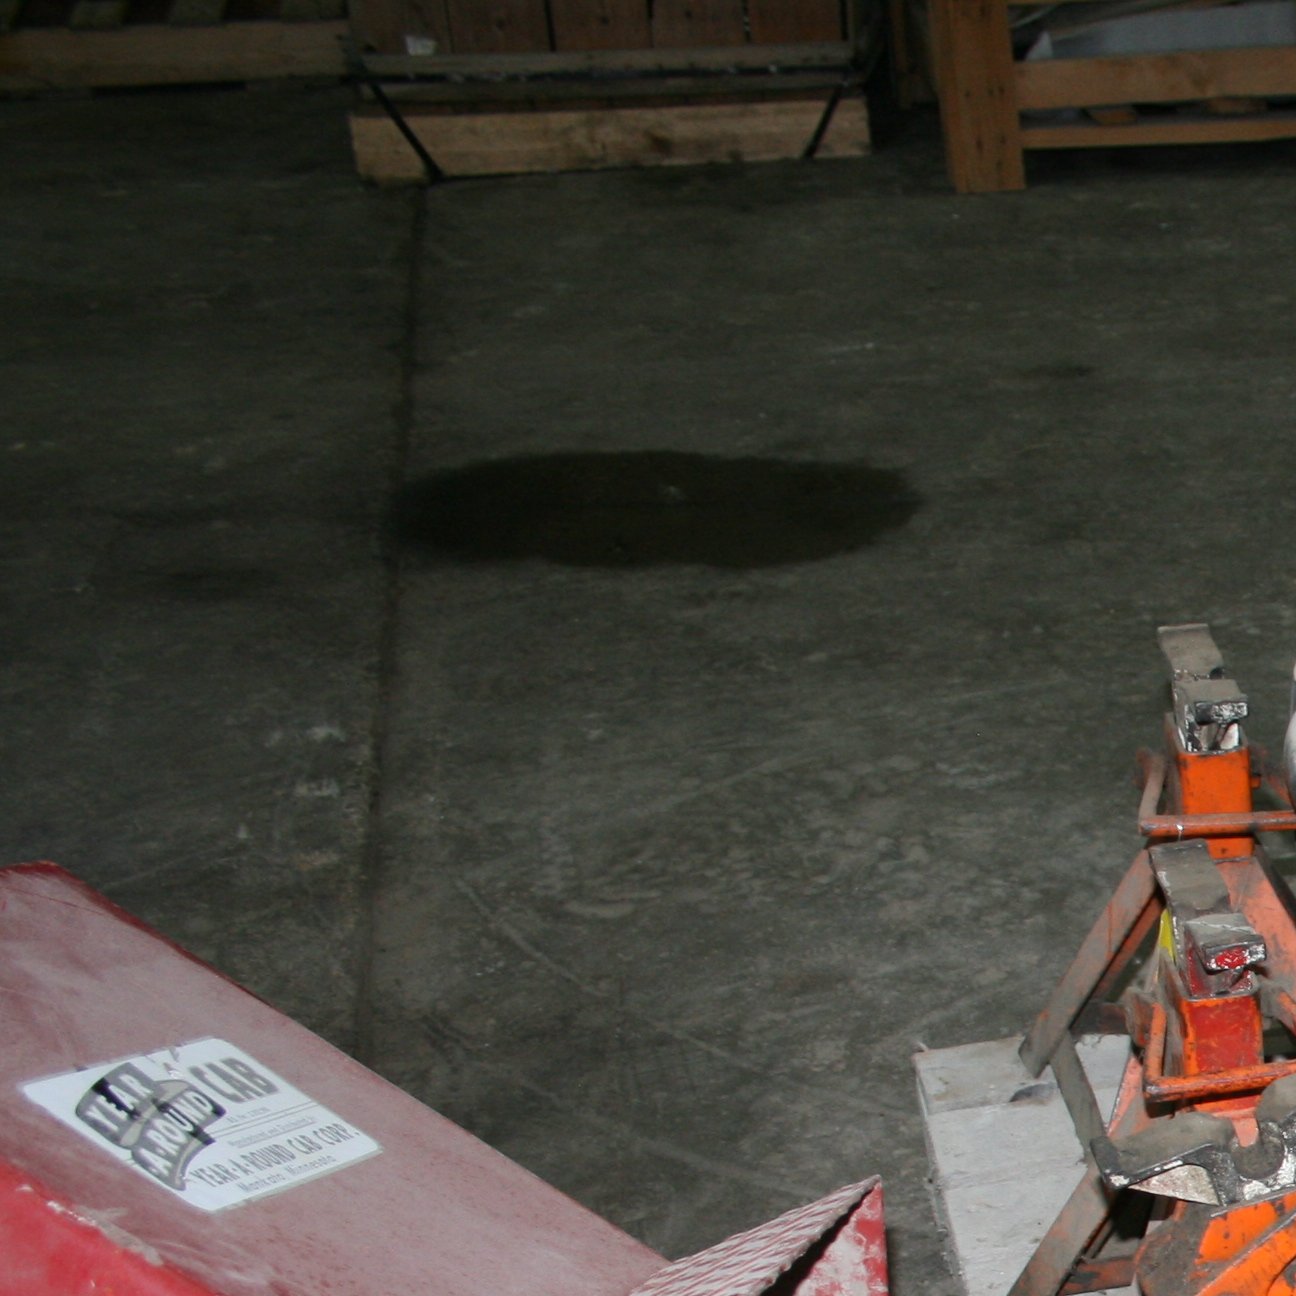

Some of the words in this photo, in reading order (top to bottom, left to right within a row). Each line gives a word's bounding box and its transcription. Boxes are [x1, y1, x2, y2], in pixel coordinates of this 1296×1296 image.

[189, 1057, 279, 1103] CAB
[85, 1073, 154, 1130] YEAR
[287, 1134, 323, 1154] CAB
[313, 1123, 361, 1145] CORP.
[284, 1154, 337, 1176] Minnesota
